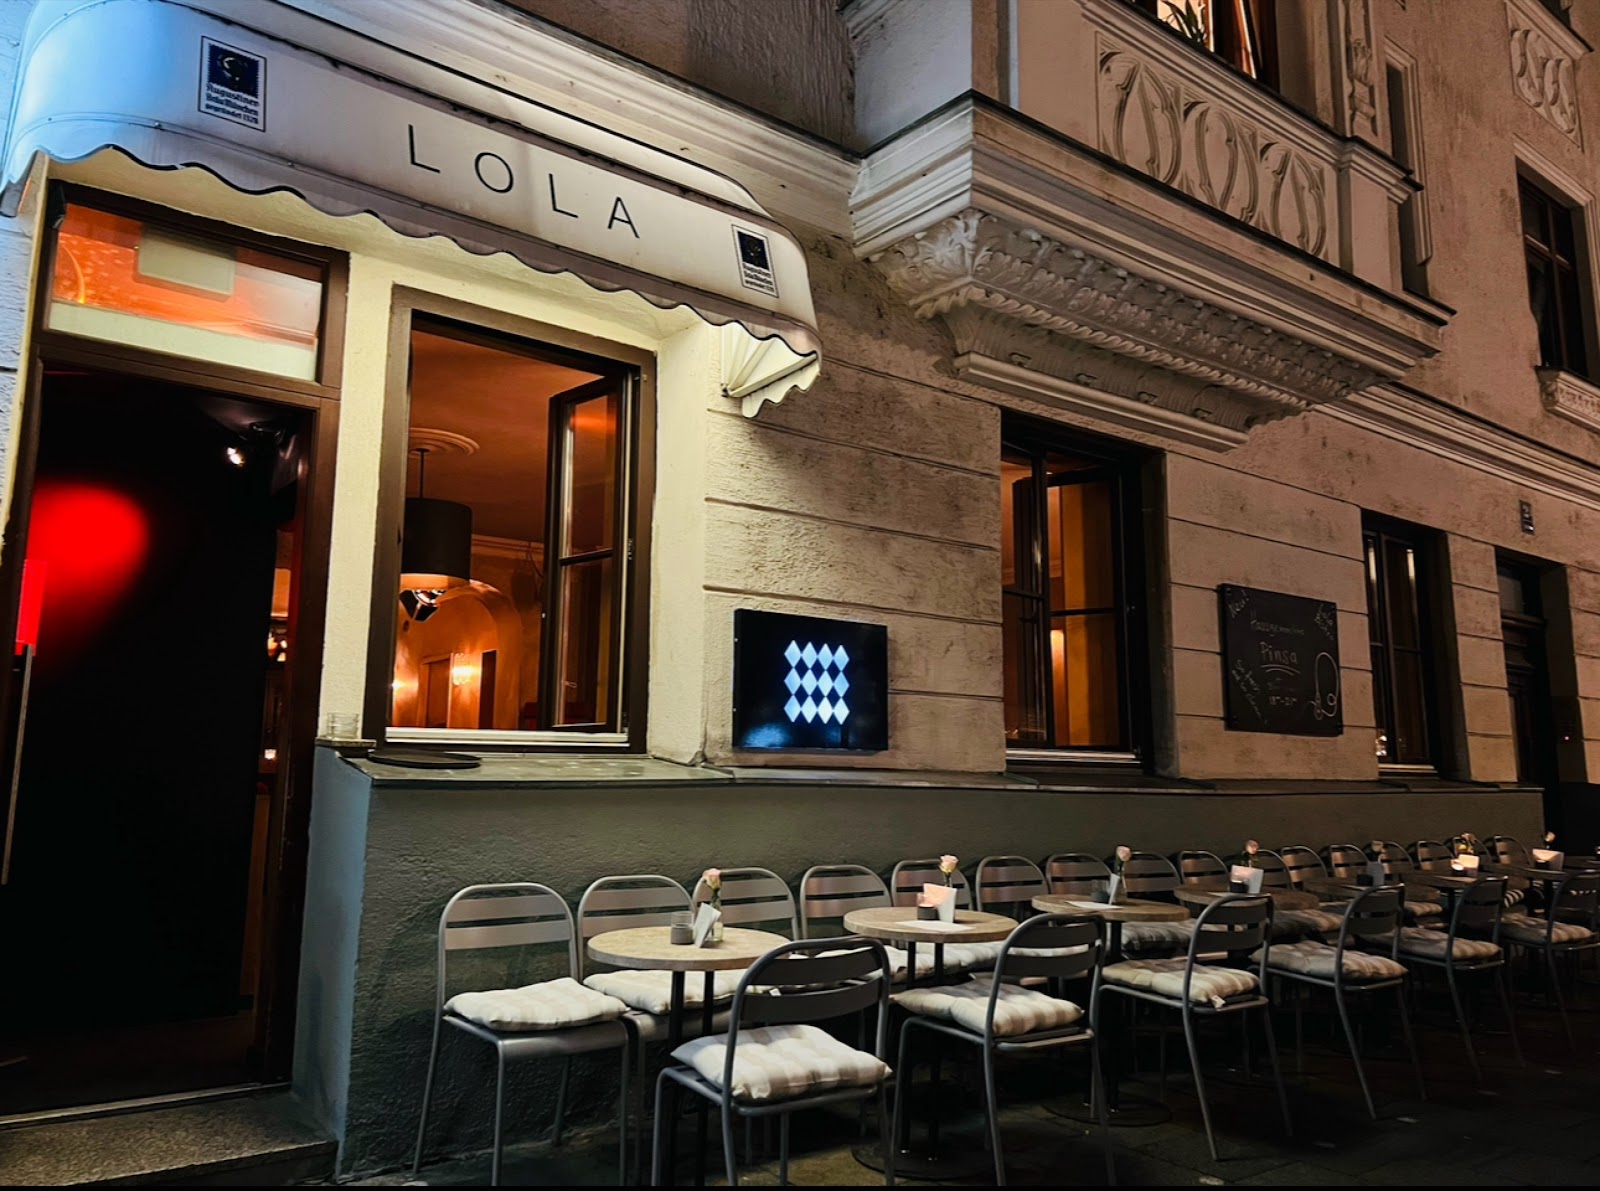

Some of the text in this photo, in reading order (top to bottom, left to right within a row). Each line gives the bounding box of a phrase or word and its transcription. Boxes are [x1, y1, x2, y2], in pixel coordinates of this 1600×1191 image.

[206, 82, 259, 107] Augustiner
[408, 123, 640, 239] LOLA
[1259, 640, 1299, 665] Pinsa
